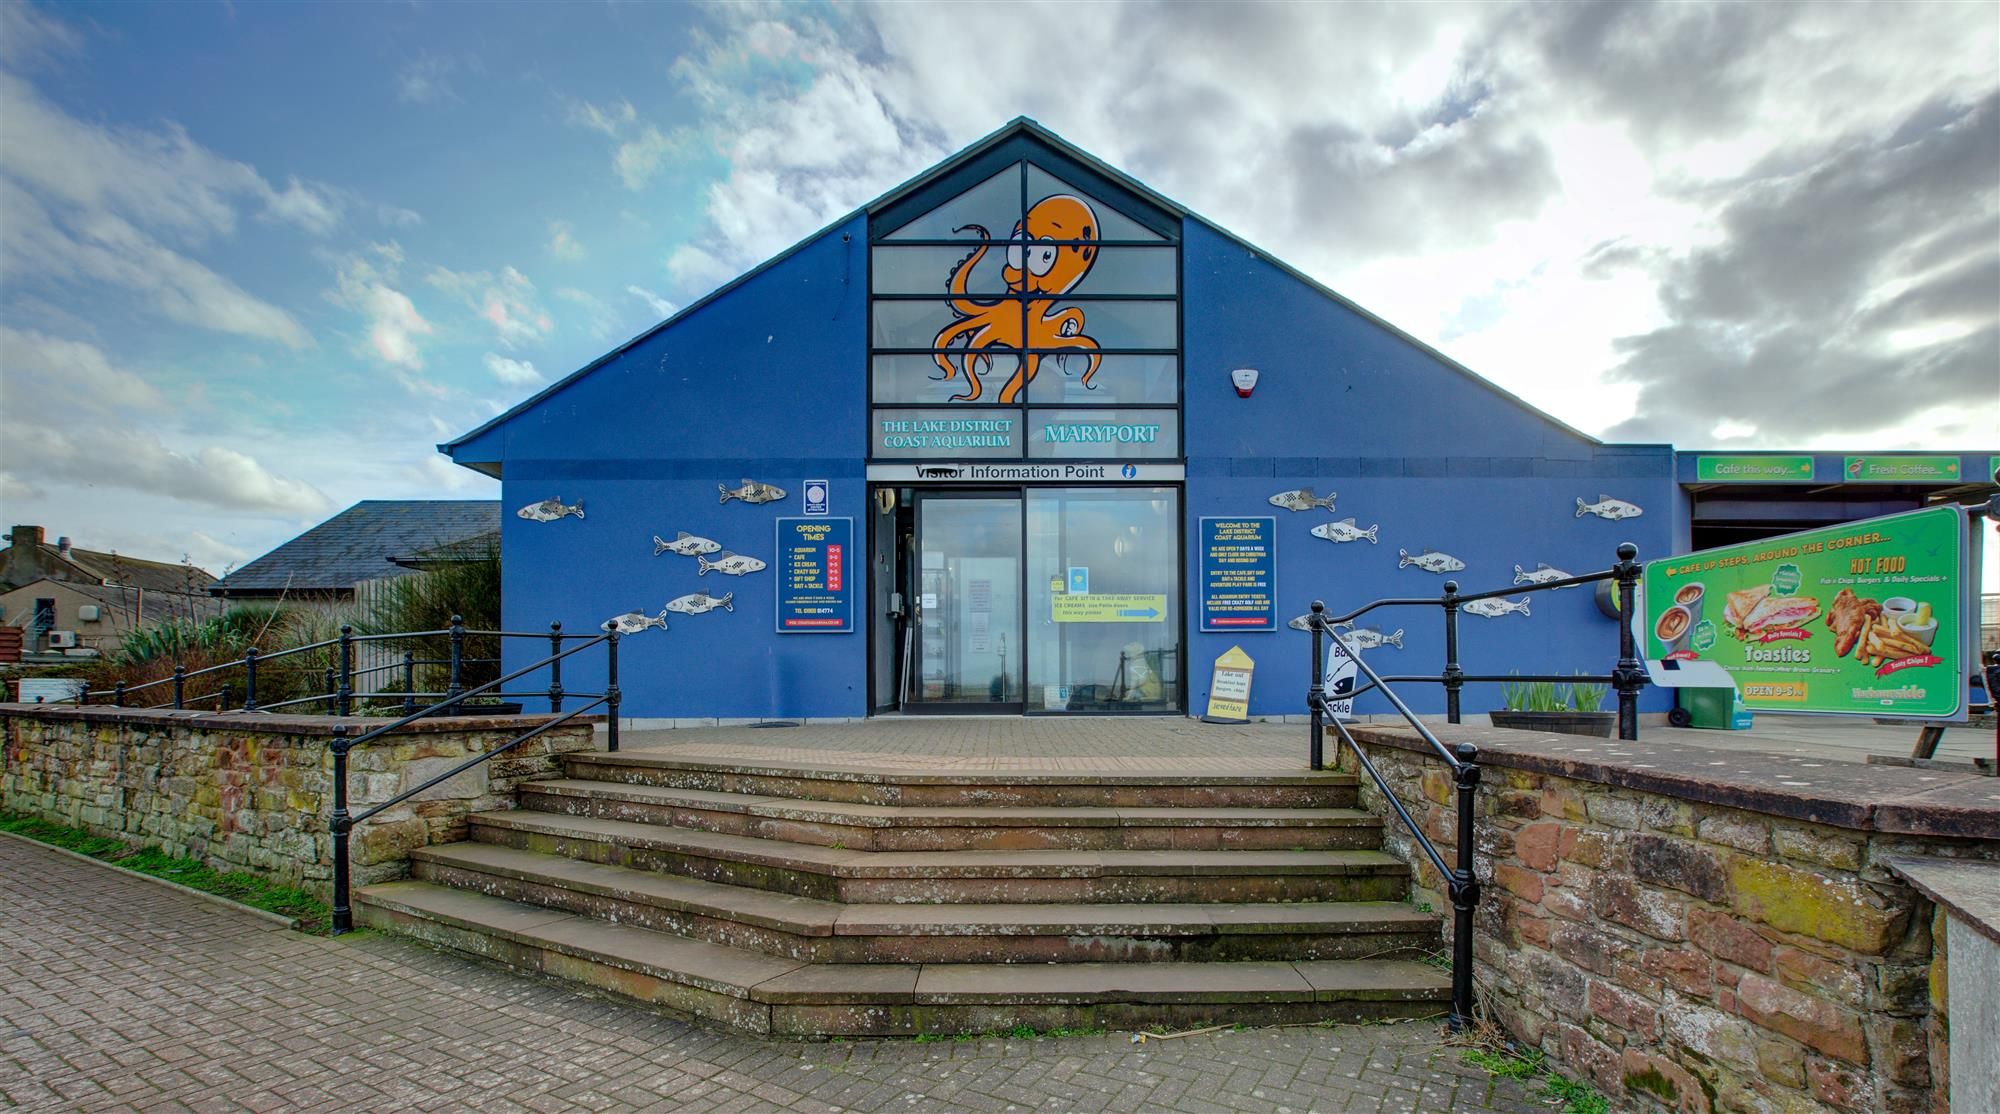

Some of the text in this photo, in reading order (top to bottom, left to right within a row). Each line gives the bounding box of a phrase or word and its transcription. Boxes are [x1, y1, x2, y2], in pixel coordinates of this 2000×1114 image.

[882, 419, 1013, 434] THE LAKE DISTRICT
[1045, 424, 1160, 443] MARYPORT
[884, 435, 1011, 449] COAST AQUARIUM
[971, 465, 1060, 479] Information
[1065, 465, 1105, 479] Point
[1743, 463, 1761, 474] this
[1869, 463, 1897, 475] Fresh
[796, 524, 832, 533] OPENING
[802, 533, 825, 541] TIMES
[1680, 563, 1701, 575] CAFE
[1703, 562, 1716, 571] UP
[1753, 547, 1799, 562] AROUND
[1802, 542, 1823, 554] THE
[1850, 556, 1906, 575] HOT FOOD
[1892, 575, 1909, 584] Daily
[1910, 575, 1940, 584] Specials
[1744, 645, 1811, 663] Toasties
[1744, 686, 1774, 697] OPEN
[1327, 701, 1350, 714] ackle
